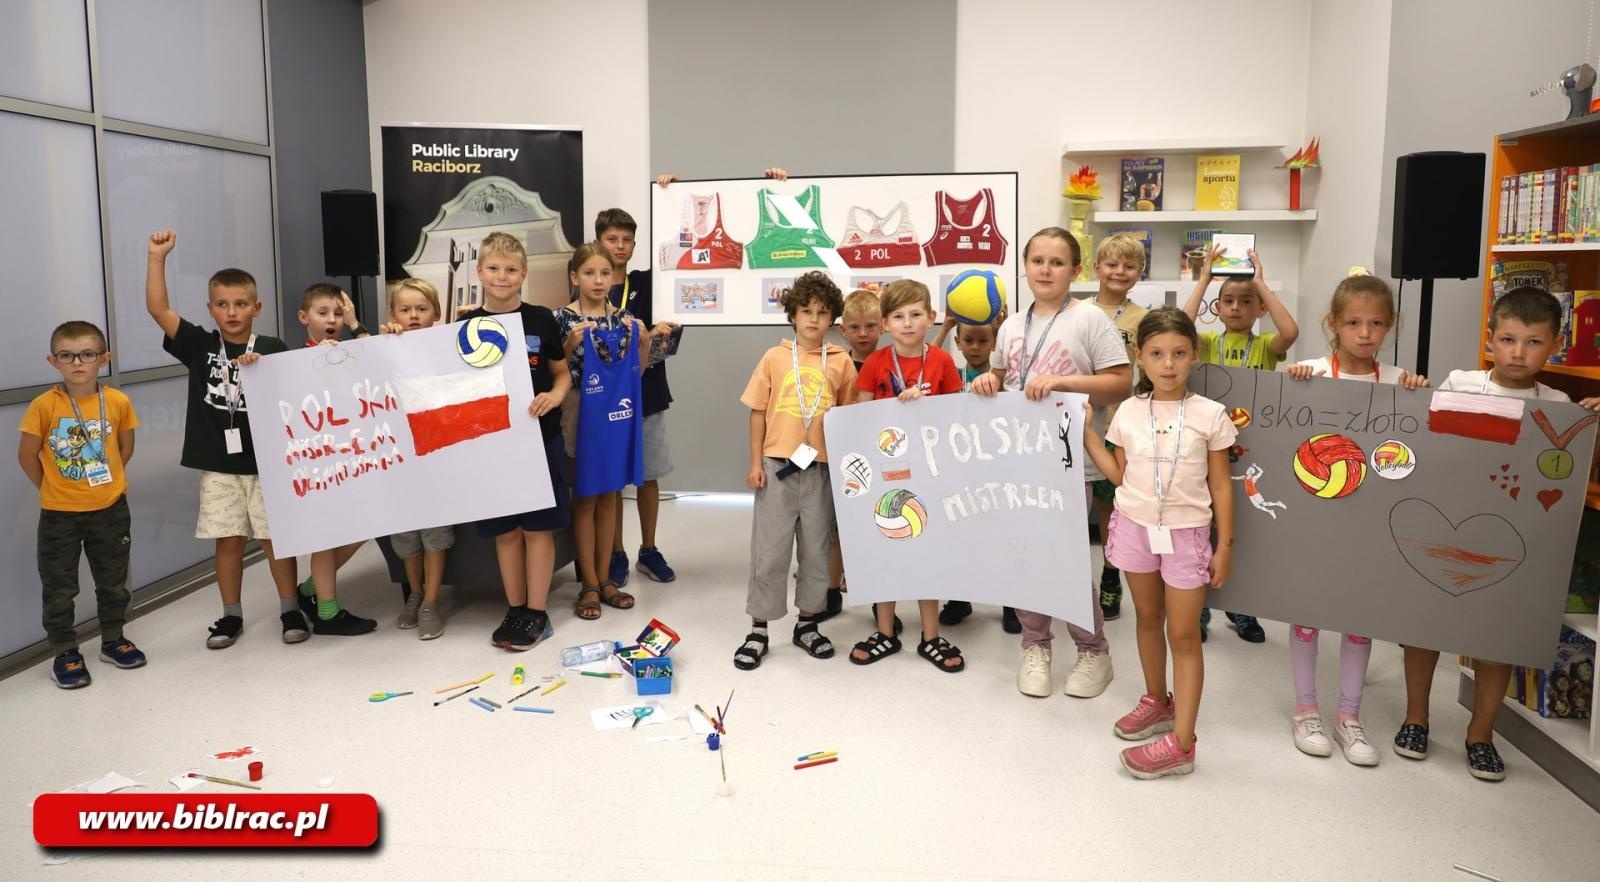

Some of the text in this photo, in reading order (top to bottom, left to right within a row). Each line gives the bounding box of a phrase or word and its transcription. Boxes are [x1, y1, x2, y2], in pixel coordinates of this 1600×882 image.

[411, 143, 519, 161] Public Library
[412, 159, 481, 174] Raciborz
[1203, 175, 1236, 184] sportu
[715, 227, 723, 240] 2
[982, 224, 991, 237] 2
[854, 248, 890, 260] 2 POL
[1513, 276, 1544, 287] TOMEK
[279, 378, 398, 439] POLSKA
[920, 416, 1056, 477] POLSKA
[1551, 454, 1561, 473] 1
